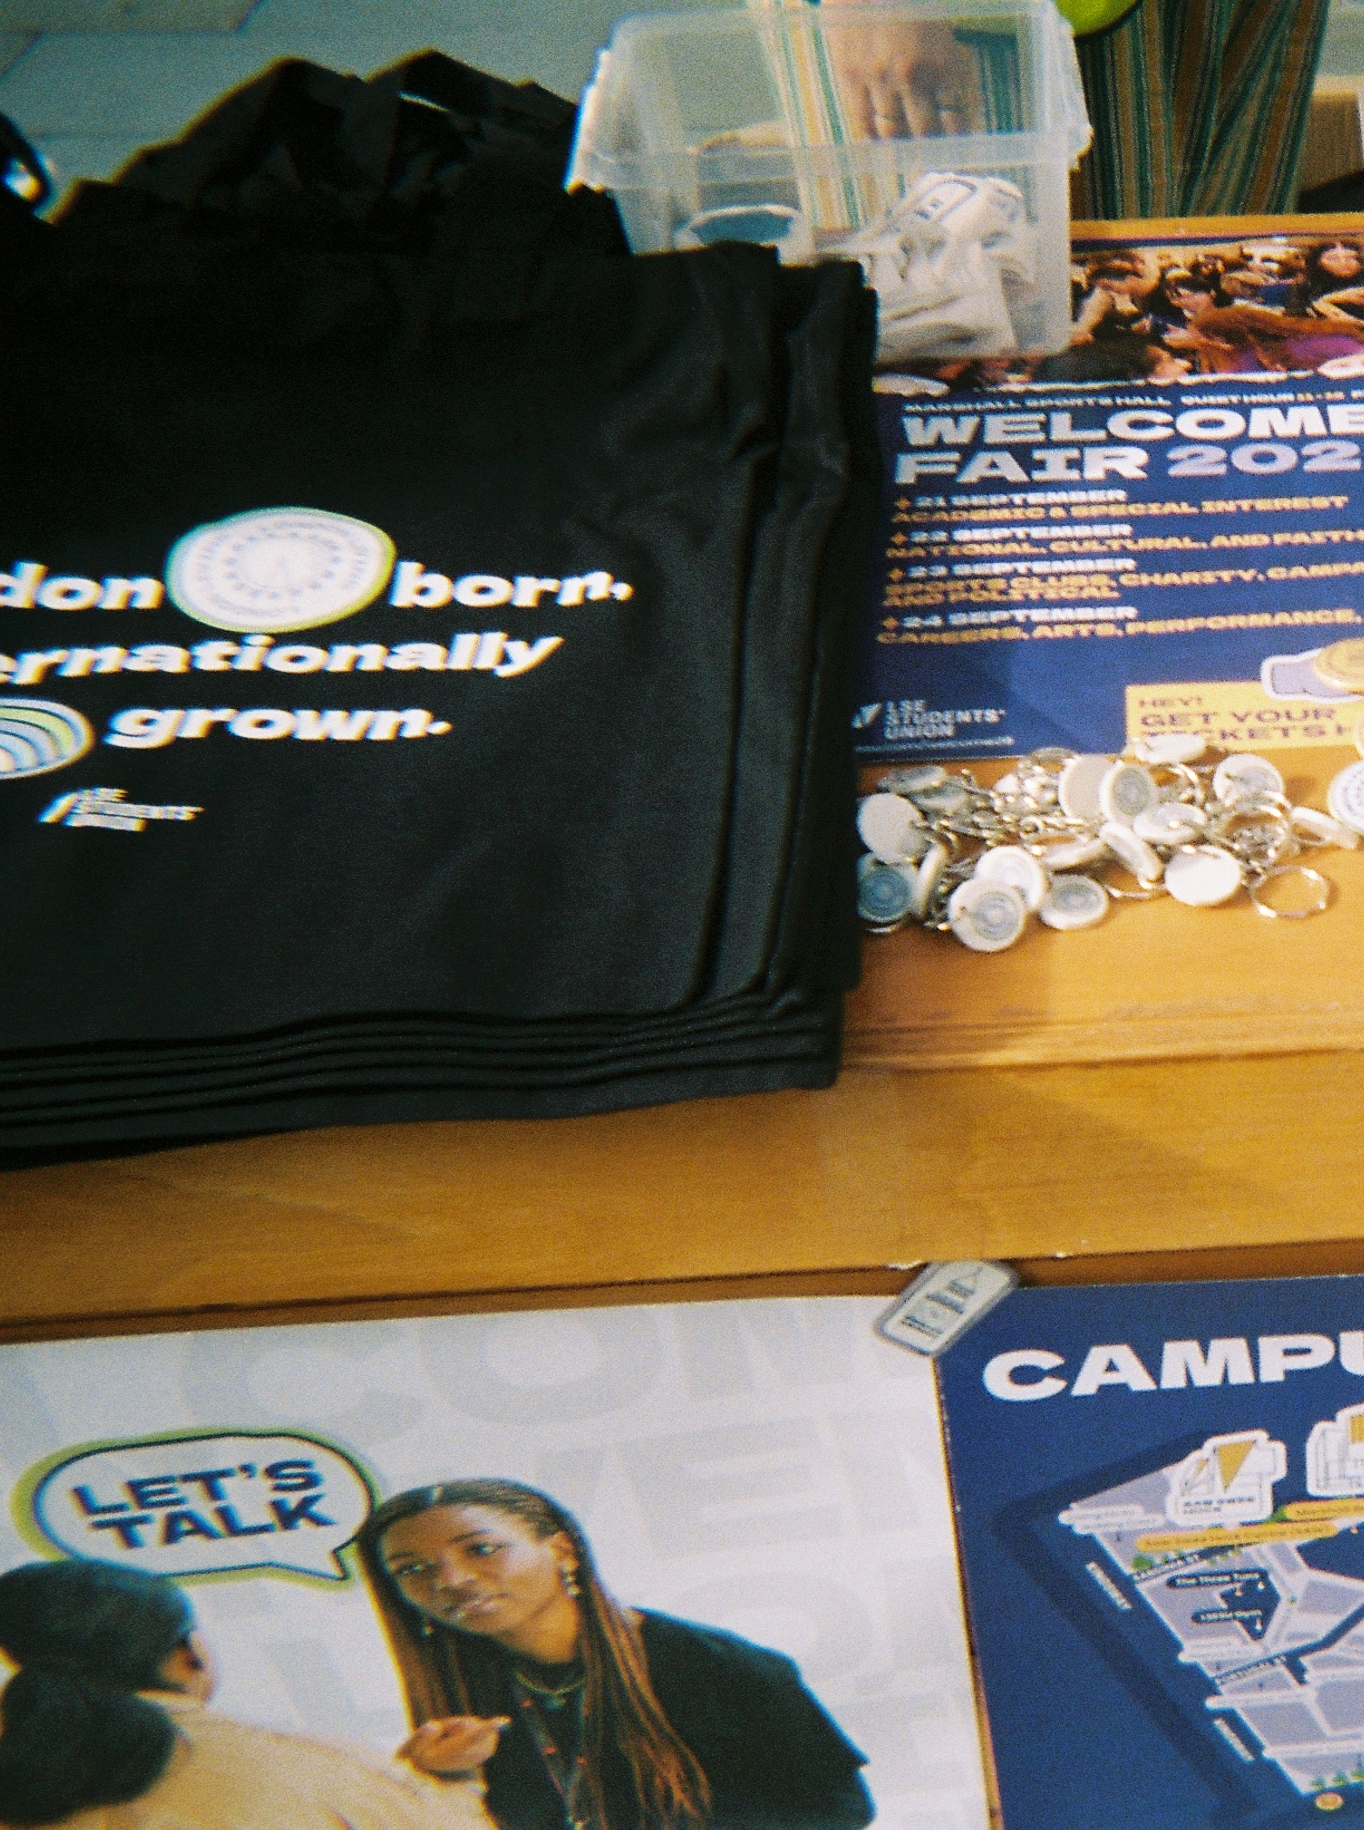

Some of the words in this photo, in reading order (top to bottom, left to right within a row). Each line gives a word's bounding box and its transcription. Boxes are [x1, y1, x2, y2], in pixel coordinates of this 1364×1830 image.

[895, 446, 1150, 484] FAIR
[892, 506, 1047, 523] ACADEMIC
[1070, 501, 1199, 519] SPECIAL
[1201, 495, 1349, 514] INTEREST
[950, 489, 1128, 508] SEPTEMBER
[952, 523, 1133, 544] SEPTEMBER
[1210, 533, 1271, 549] AND
[951, 557, 1137, 578] SEPTEMBER
[1119, 567, 1267, 588] CHARITY,
[388, 559, 634, 609] born.
[948, 606, 1138, 627] SEPTEMBER
[1125, 608, 1363, 636] PERFORMANCE,
[103, 705, 454, 750] grown.
[1140, 711, 1218, 728] GET
[1230, 708, 1337, 725] YOUR
[70, 1457, 325, 1517] LET'S
[91, 1491, 337, 1550] TALK
